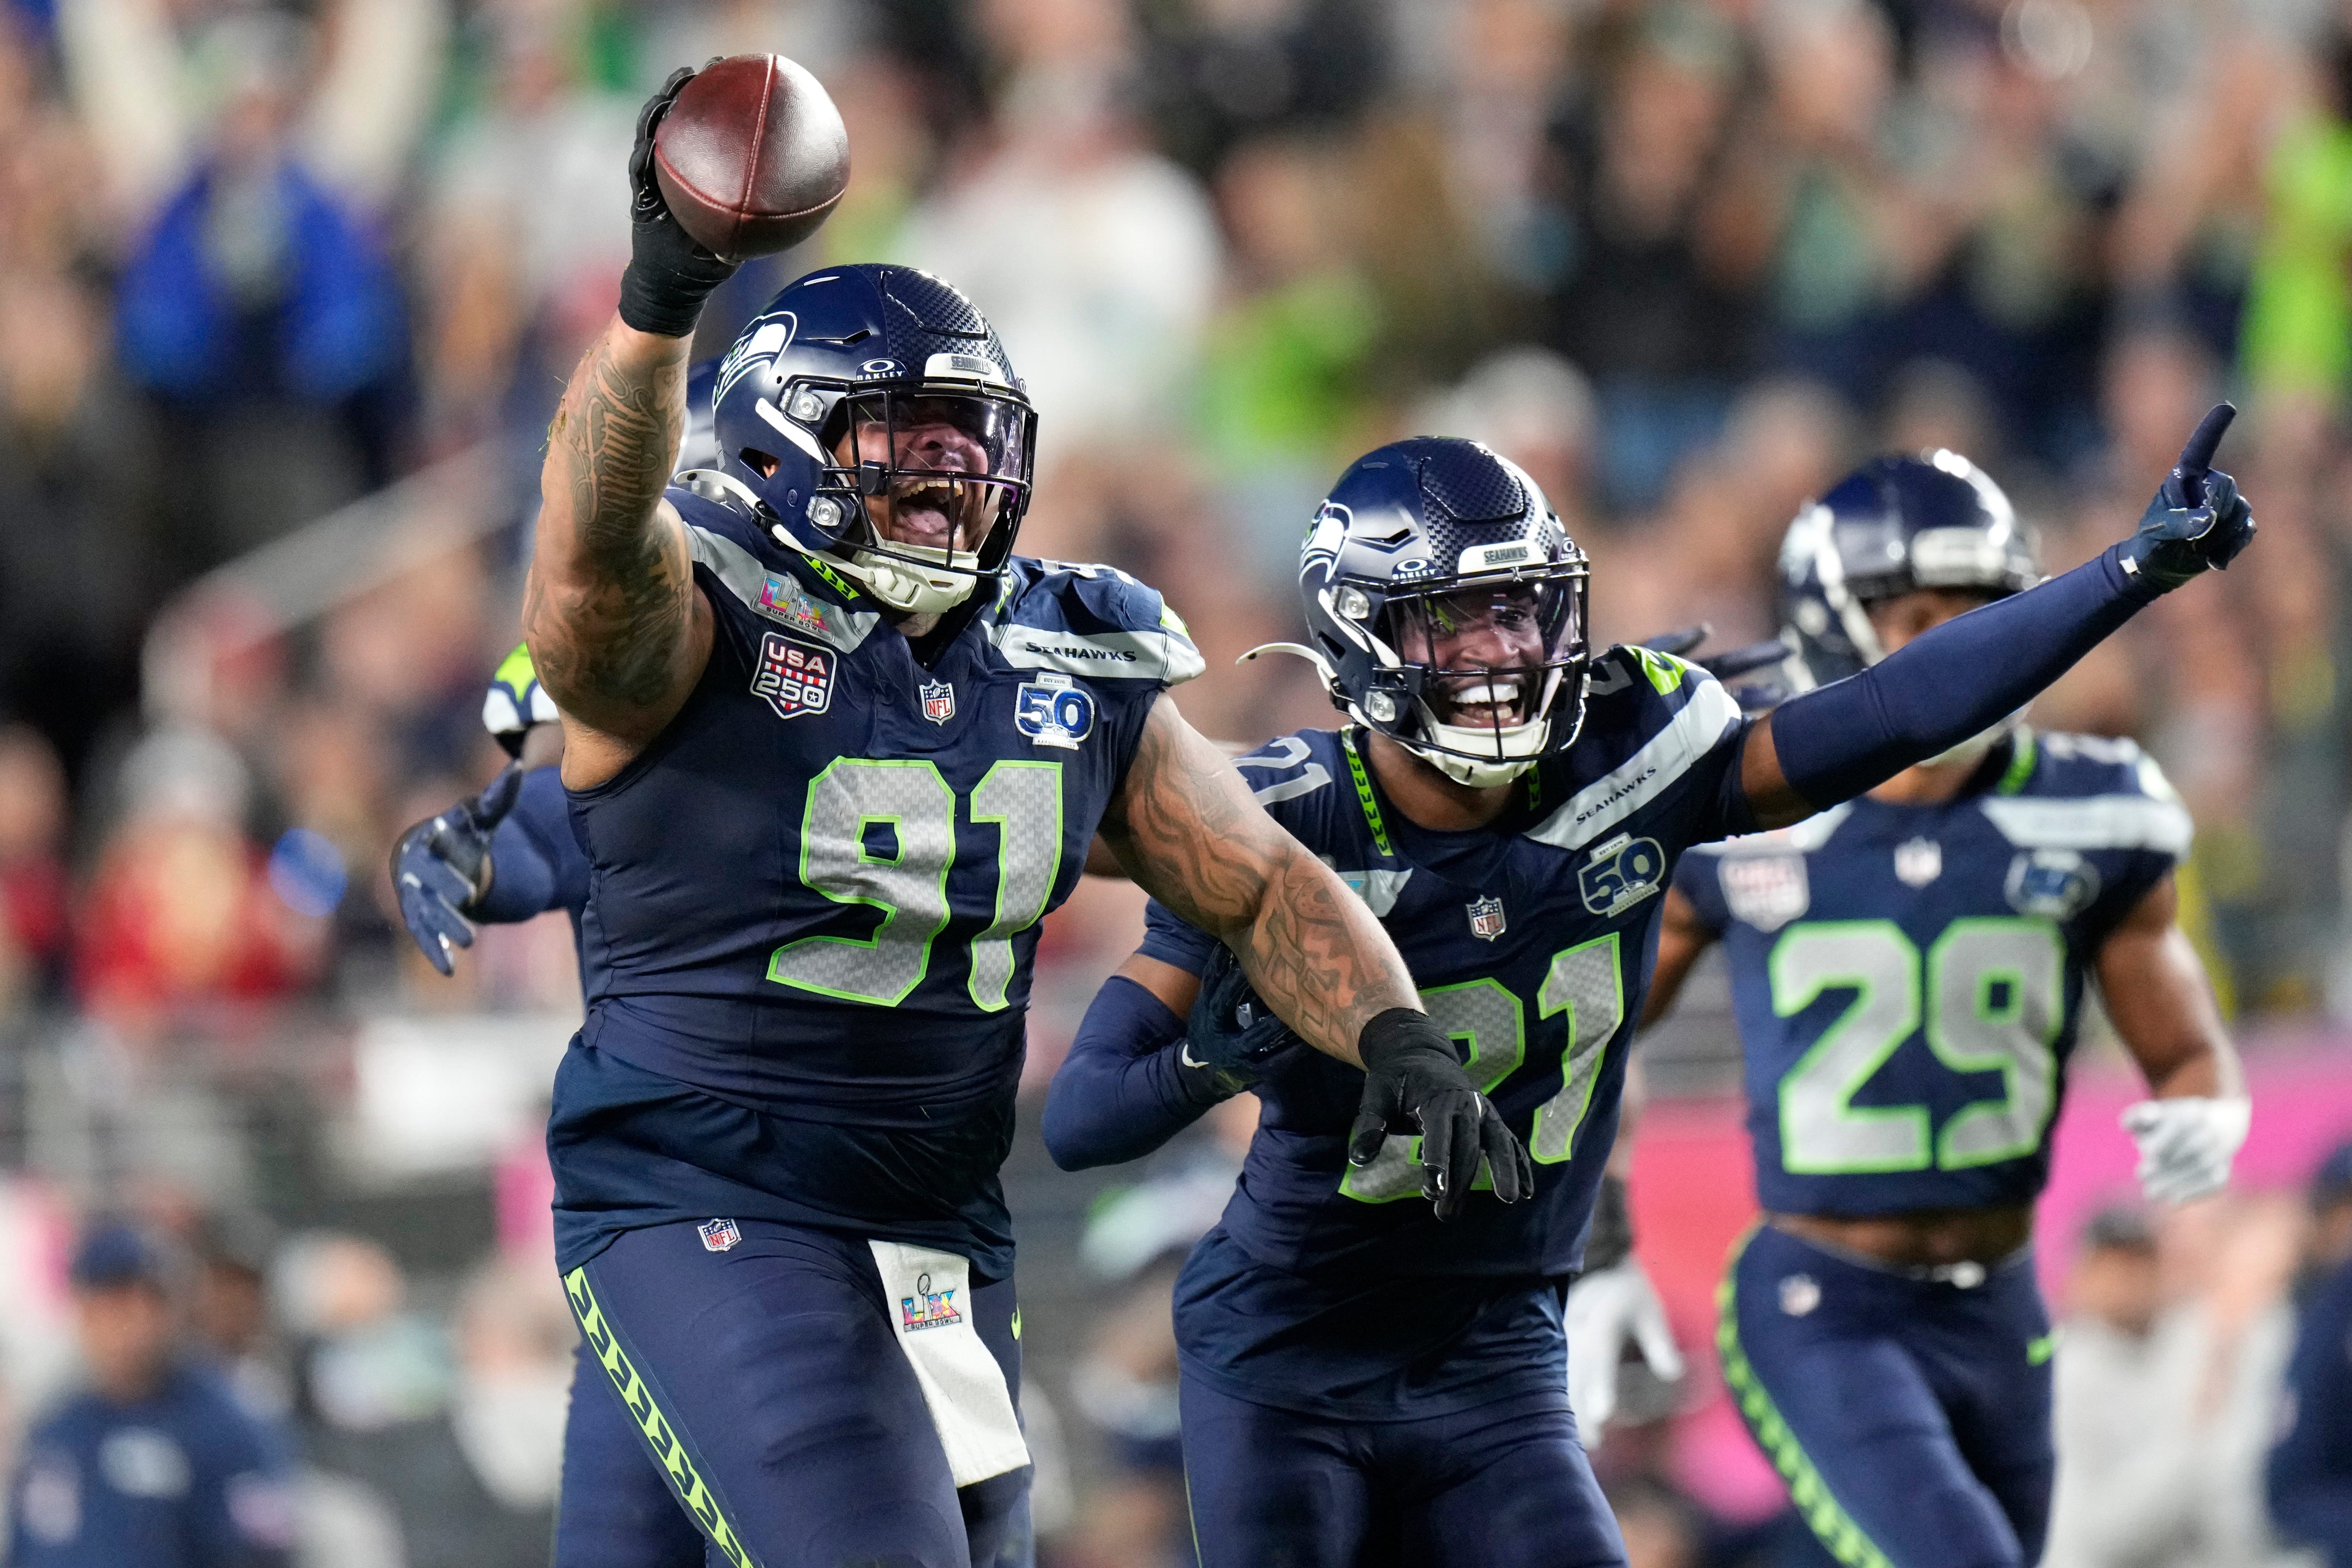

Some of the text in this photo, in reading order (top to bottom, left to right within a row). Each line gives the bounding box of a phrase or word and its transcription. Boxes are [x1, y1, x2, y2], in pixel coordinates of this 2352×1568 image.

[857, 371, 903, 381] OAKLEY
[951, 356, 992, 375] SEAHAWKS
[1392, 568, 1435, 580] OAKLEY
[766, 606, 795, 622] SUPER
[798, 620, 822, 633] BOWL
[768, 642, 826, 675] USA
[1025, 642, 1137, 662] SEAHAWKS
[755, 672, 824, 708] 250
[928, 699, 950, 717] NFL
[1019, 687, 1091, 739] 50
[1576, 766, 1657, 825] SEAHAWKS
[766, 756, 1062, 1012] 91
[1582, 841, 1662, 911] 50
[1476, 915, 1500, 933] NFL
[1768, 916, 2068, 1175] 29
[709, 1230, 735, 1246] NFL
[911, 1320, 933, 1330] SUPER
